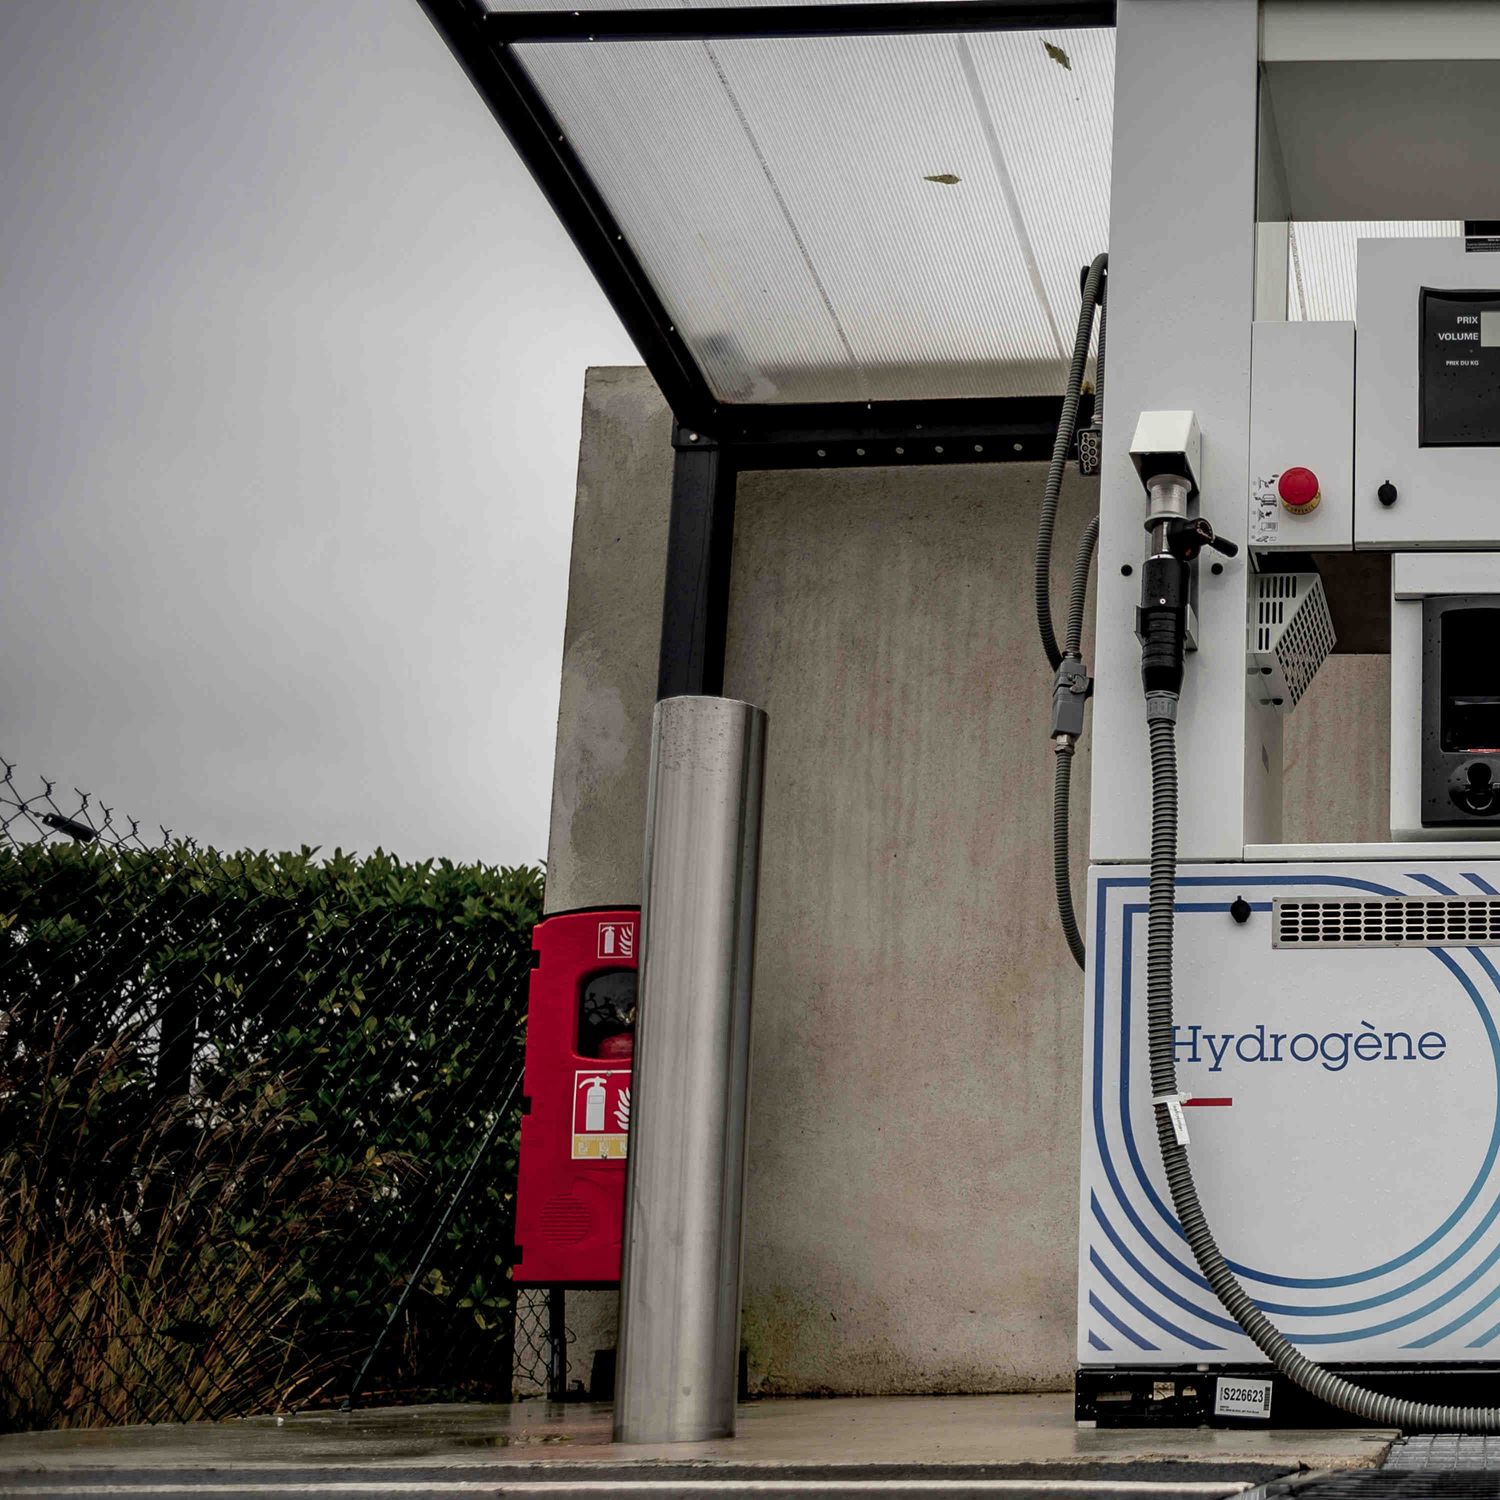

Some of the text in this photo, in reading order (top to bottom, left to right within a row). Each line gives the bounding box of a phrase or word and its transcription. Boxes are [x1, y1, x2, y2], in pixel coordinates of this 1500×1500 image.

[1456, 316, 1478, 324] PRIX
[1438, 332, 1479, 341] VOLUME
[1171, 1020, 1447, 1072] Hydrogène
[1223, 1387, 1264, 1403] S226623
